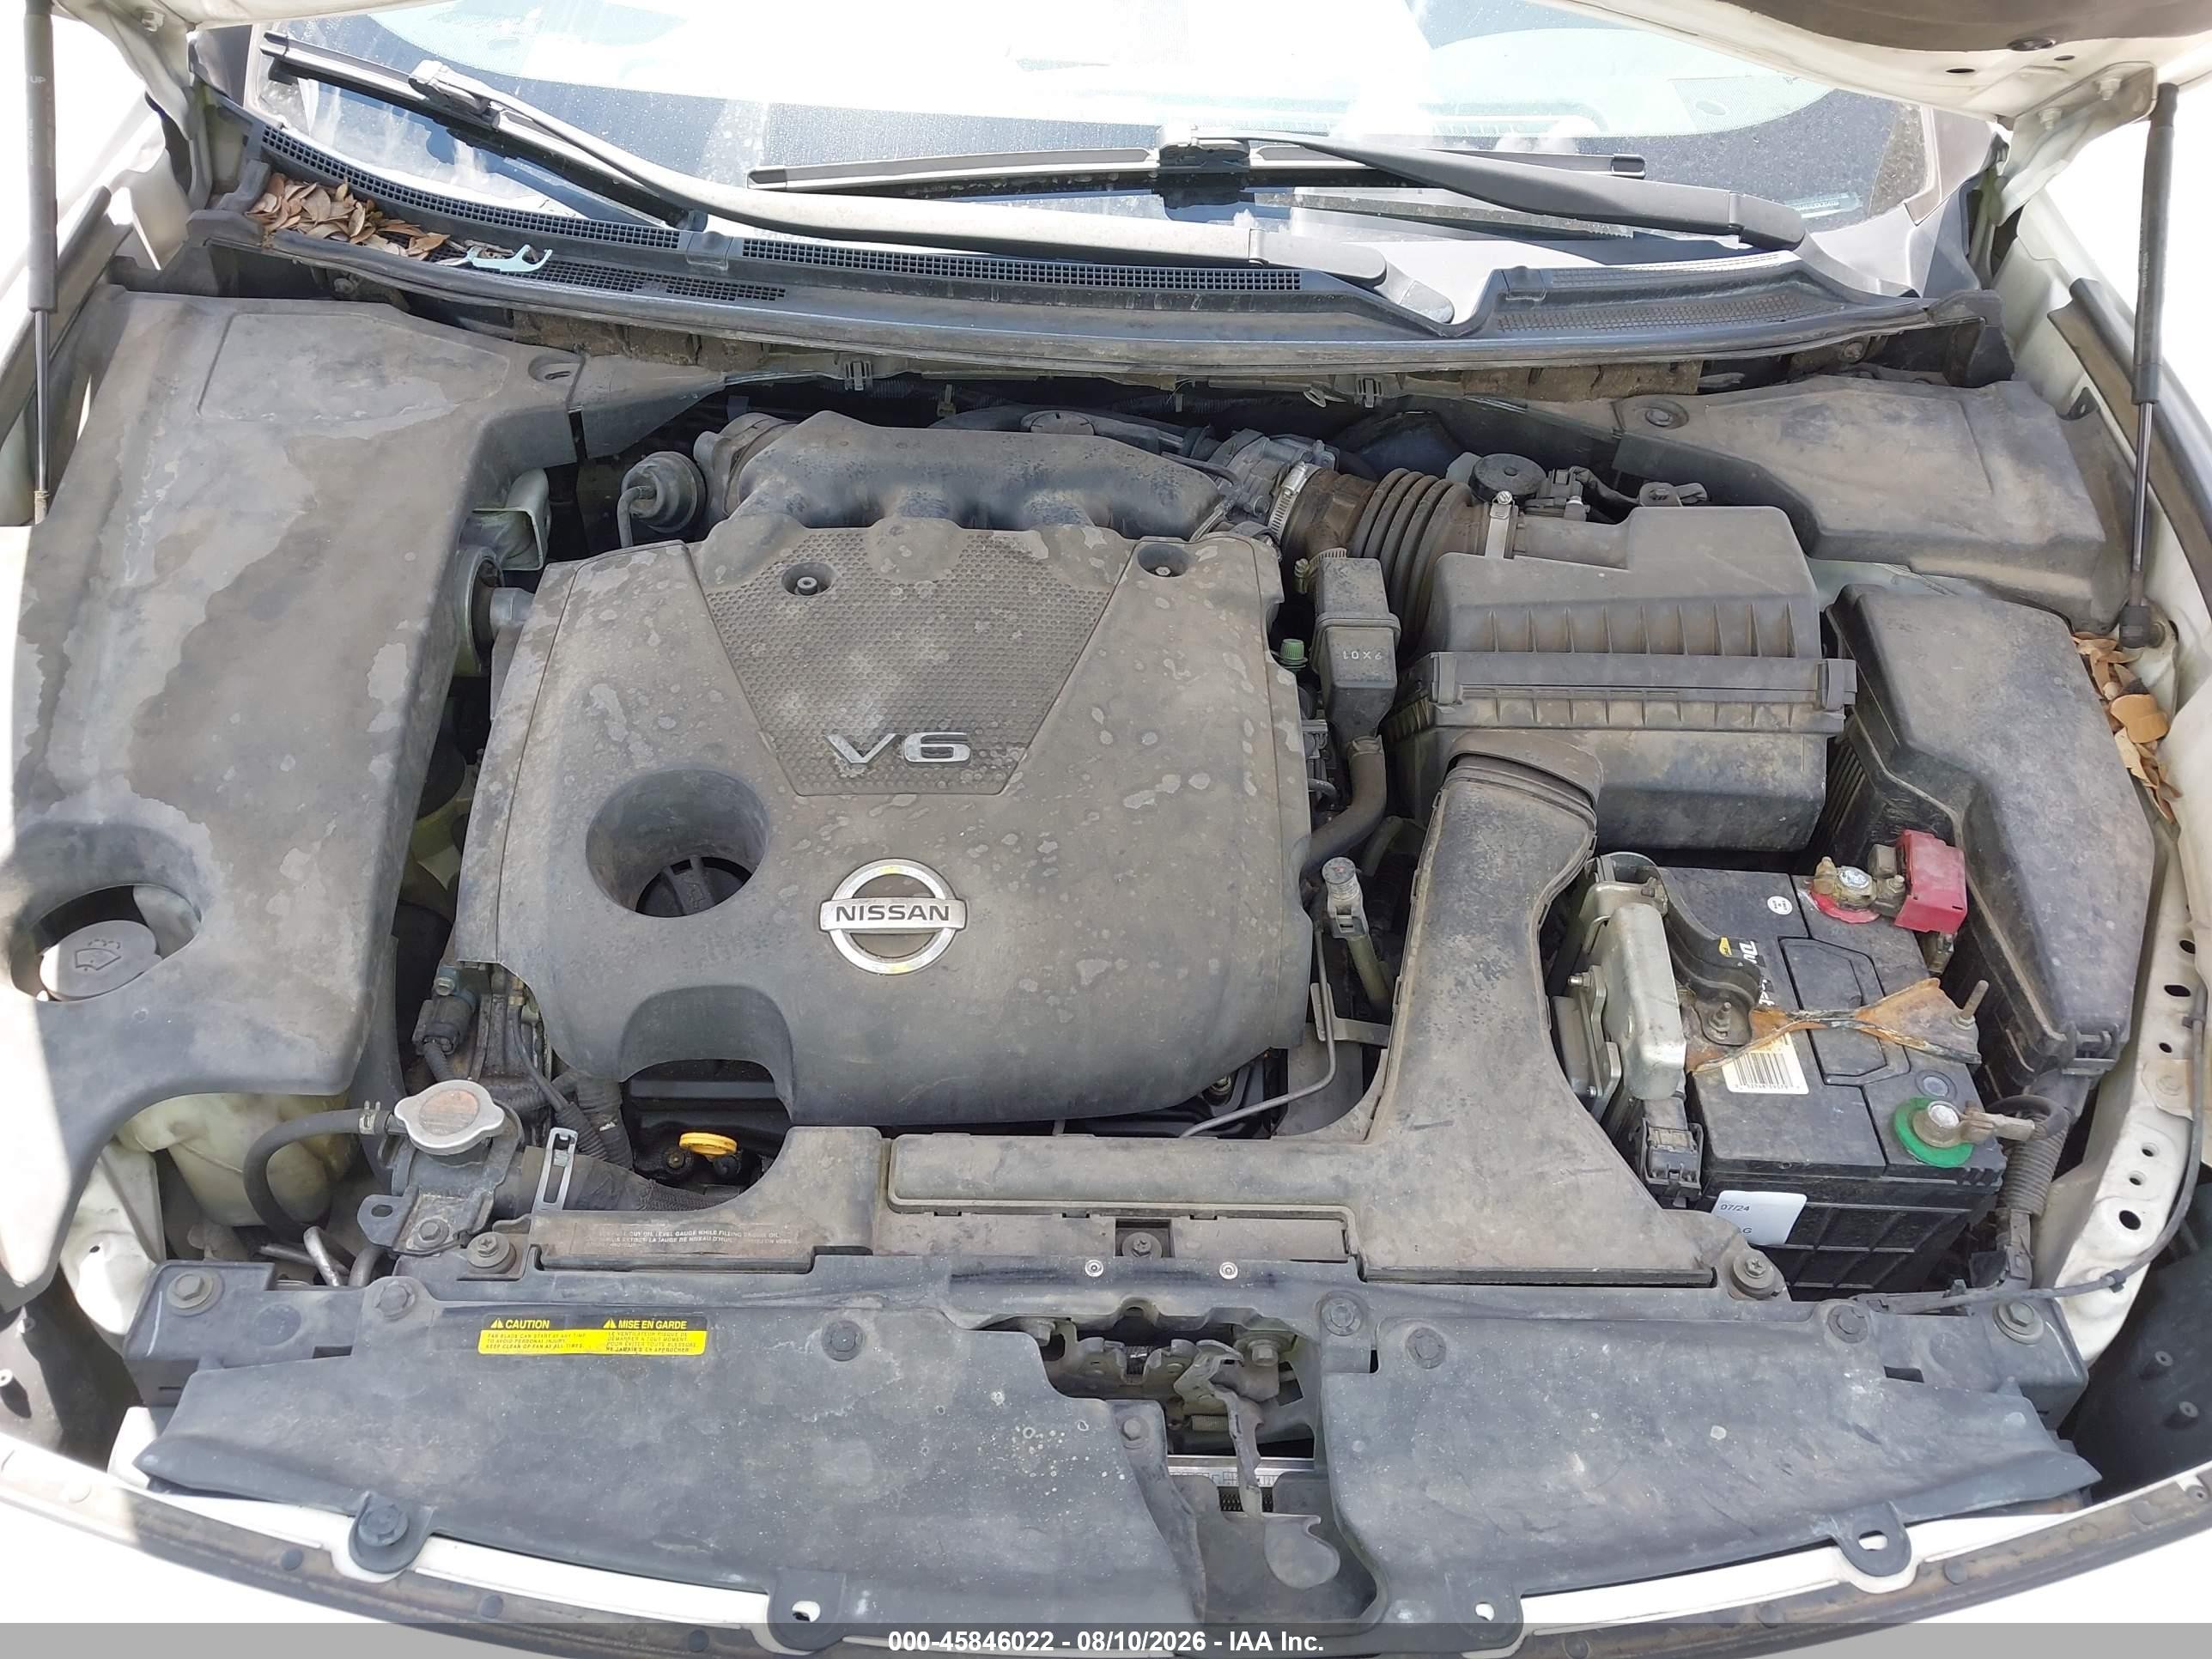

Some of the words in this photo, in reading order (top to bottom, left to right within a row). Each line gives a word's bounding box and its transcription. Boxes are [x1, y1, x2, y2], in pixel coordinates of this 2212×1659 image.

[824, 732, 972, 765] V6
[836, 904, 950, 921] NISSAN
[506, 1319, 550, 1329] CAUTION
[618, 1320, 641, 1329] MISE
[641, 1321, 654, 1329] EN
[655, 1321, 687, 1329] GARDE
